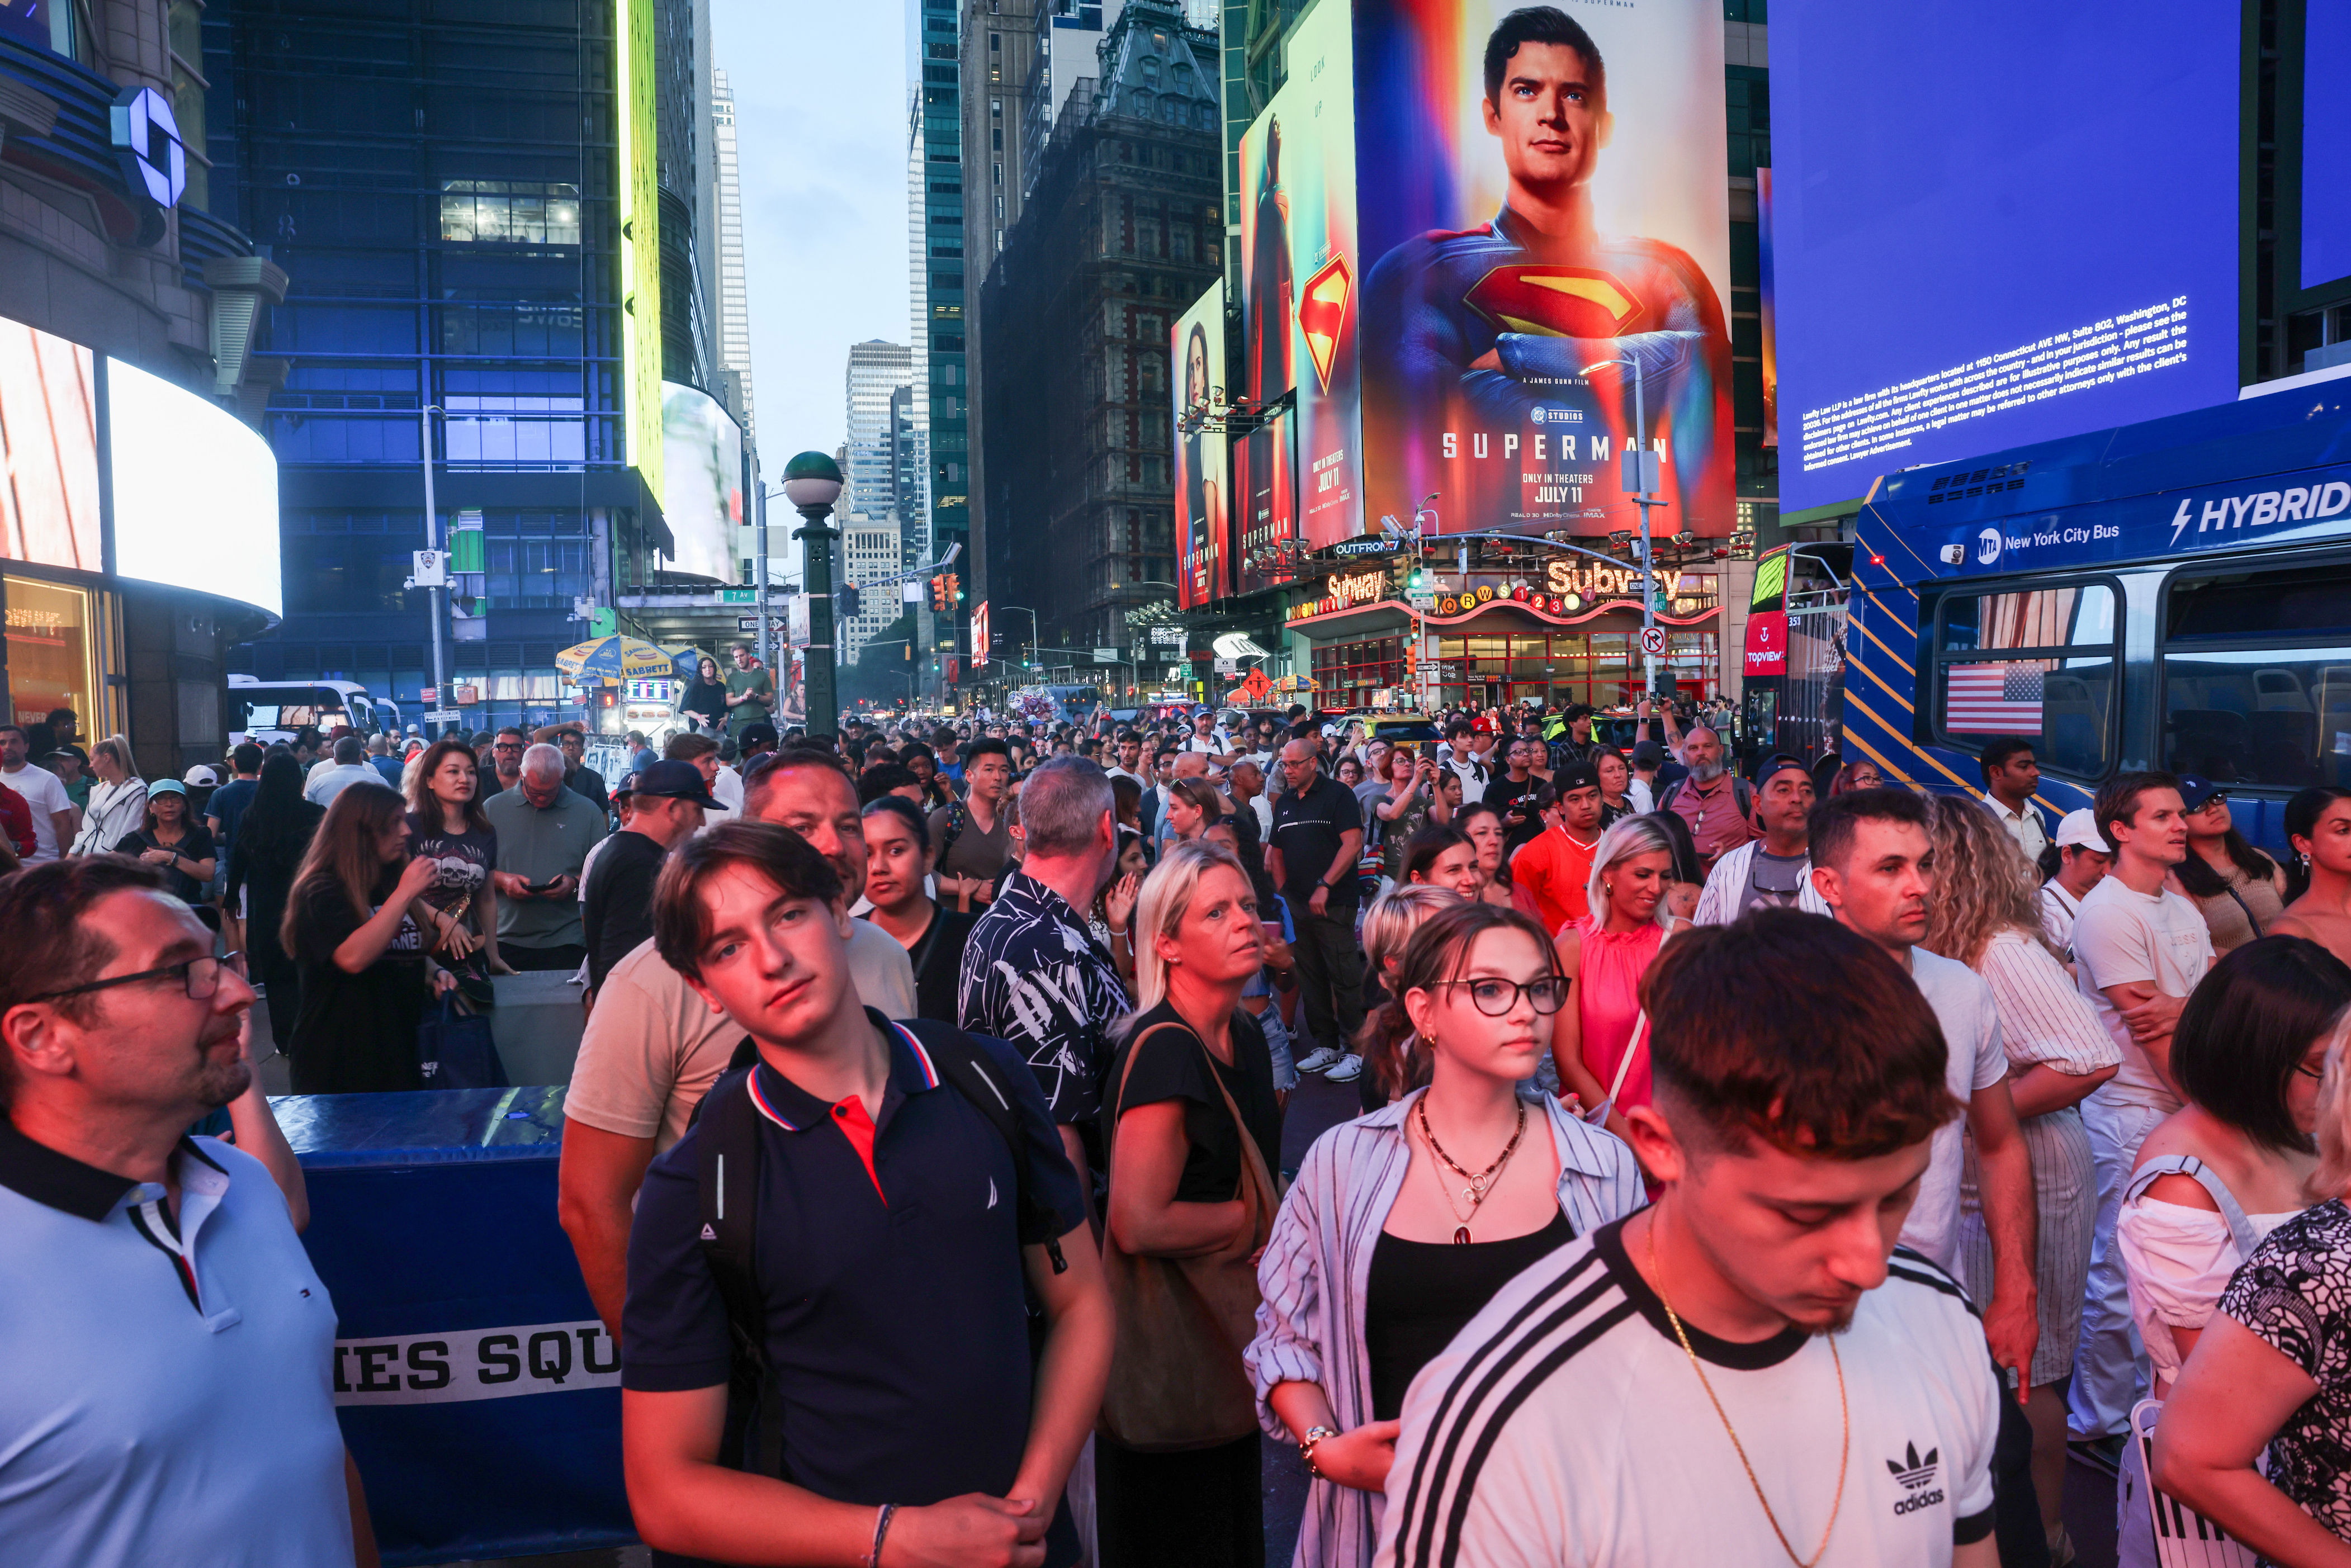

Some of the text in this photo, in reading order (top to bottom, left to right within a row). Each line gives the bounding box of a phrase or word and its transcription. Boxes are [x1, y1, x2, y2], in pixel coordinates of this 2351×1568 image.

[1311, 55, 1324, 82] LOOK
[1315, 100, 1322, 118] UP
[1803, 409, 1820, 420] Lawfty
[1820, 406, 1831, 415] Law
[1832, 402, 1842, 412] LLP
[1853, 397, 1863, 405] law
[1864, 393, 1876, 402] firm
[1877, 387, 1890, 398] with
[1891, 386, 1899, 394] its
[1900, 374, 1940, 391] headquarters
[1941, 363, 1965, 379] located
[1966, 362, 1974, 371] at
[1975, 356, 1992, 368] 1150
[1993, 343, 2036, 363] Connecticut
[2037, 337, 2053, 349] AVE
[2055, 332, 2071, 344] NW,
[2073, 326, 2093, 339] Suite
[2095, 319, 2115, 331] 802,
[2116, 304, 2170, 325] Washington,
[2173, 295, 2187, 308] DC
[1803, 419, 1822, 431] 20036.
[1822, 417, 1831, 425] For
[1831, 414, 1841, 423] the
[1841, 406, 1868, 420] addresses
[1868, 402, 1875, 412] of
[1882, 399, 1893, 408] the
[1893, 395, 1908, 405] firms
[1909, 387, 1929, 400] Lawfty
[1929, 382, 1948, 394] works
[1948, 377, 1963, 388] with
[1964, 372, 1985, 384] across
[1985, 367, 1998, 377] the
[1998, 359, 2026, 373] country
[2031, 351, 2045, 364] and
[2046, 350, 2054, 359] in
[2055, 345, 2073, 359] your
[2073, 332, 2117, 354] jurisdiction
[2125, 321, 2153, 338] please
[2154, 316, 2170, 328] see
[2170, 311, 2187, 323] the
[1548, 412, 1583, 420] STUDIOS
[1803, 448, 1826, 461] obtained
[1827, 447, 1835, 456] for
[1835, 443, 1851, 453] other
[1851, 438, 1871, 449] clients.
[1879, 432, 1895, 442] some
[1895, 424, 1925, 437] instances,
[1931, 416, 1947, 429] legal
[1948, 412, 1970, 424] matter
[1971, 408, 1986, 418] may
[1986, 404, 1996, 414] be
[1997, 395, 2026, 410] referred
[2027, 394, 2036, 402] to
[2037, 389, 2057, 400] other
[2059, 378, 2095, 394] attorneys
[2097, 372, 2115, 384] only
[2116, 366, 2135, 378] with
[2137, 362, 2152, 373] the
[2154, 353, 2187, 368] client's
[1803, 428, 1832, 440] disclaimers
[1313, 449, 1344, 473] ONLY IN THEATERS
[1804, 438, 1912, 471] informed consent. Lawyer Advertisement.
[1318, 467, 1339, 493] JULY 11
[1522, 473, 1593, 484] ONLY IN THEATERS
[1339, 492, 1350, 503] IMAX
[1535, 486, 1582, 503] JULY 11
[2198, 481, 2350, 533] HYBRID
[1243, 517, 1288, 549] SUPERMAN
[1979, 524, 2120, 556] MTA New York City Bus
[1183, 542, 1218, 571] SUPERMAN
[732, 592, 736, 601] 7
[1328, 570, 1383, 603] Subway
[1445, 586, 1592, 612] Q R W S 1 2 3 7
[1332, 599, 1336, 609] 3
[1789, 616, 1801, 627] 351
[626, 664, 669, 676] SABRETT
[606, 695, 612, 707] 9
[18, 710, 47, 723] NEVER
[1894, 1489, 1945, 1515] adidas
